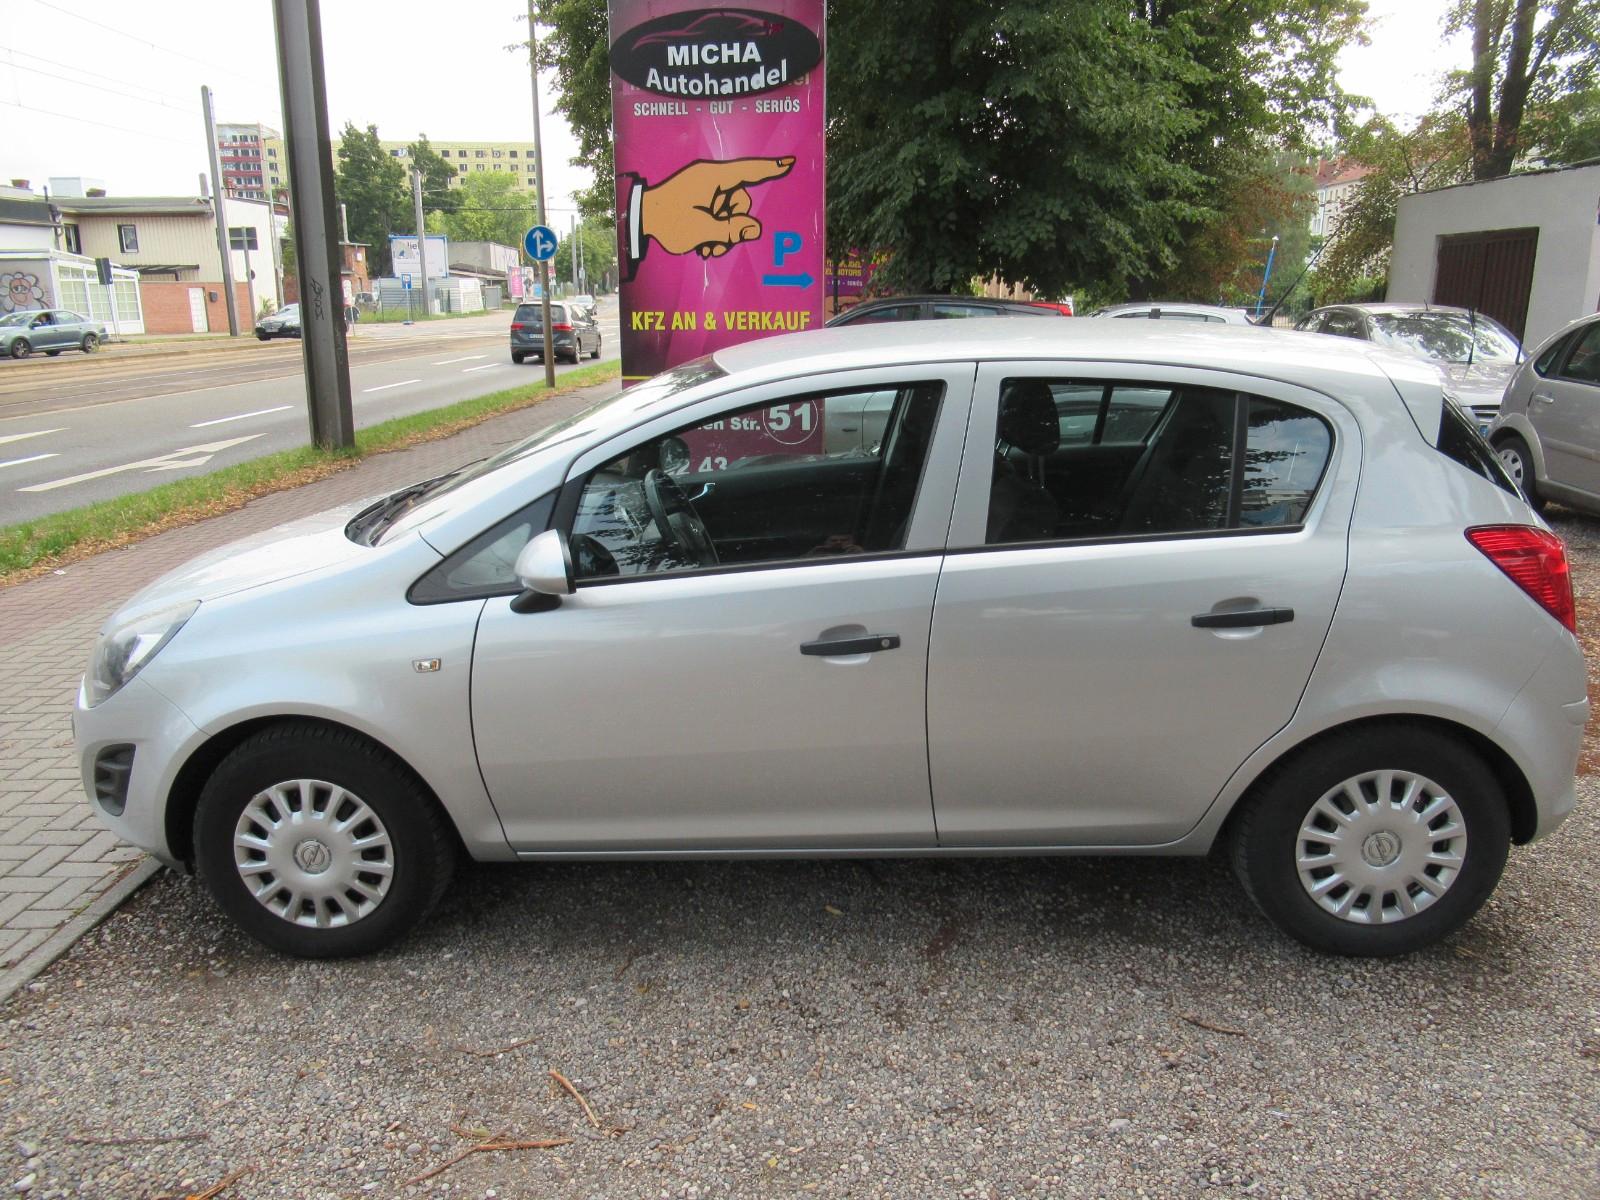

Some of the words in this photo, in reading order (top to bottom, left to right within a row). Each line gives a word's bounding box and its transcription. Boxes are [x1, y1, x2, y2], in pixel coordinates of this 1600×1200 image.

[667, 42, 762, 66] MICHA
[646, 59, 788, 95] Autohandel
[633, 101, 688, 116] SCHNELL
[709, 101, 734, 114] GUT
[755, 97, 800, 113] SERIÖS
[773, 232, 802, 268] P
[632, 312, 666, 331] KFZ
[672, 312, 697, 331] AN
[704, 312, 717, 331] &
[724, 311, 810, 330] VERKAUF
[698, 419, 724, 430] en
[730, 417, 761, 431] Str.
[768, 402, 811, 431] 51
